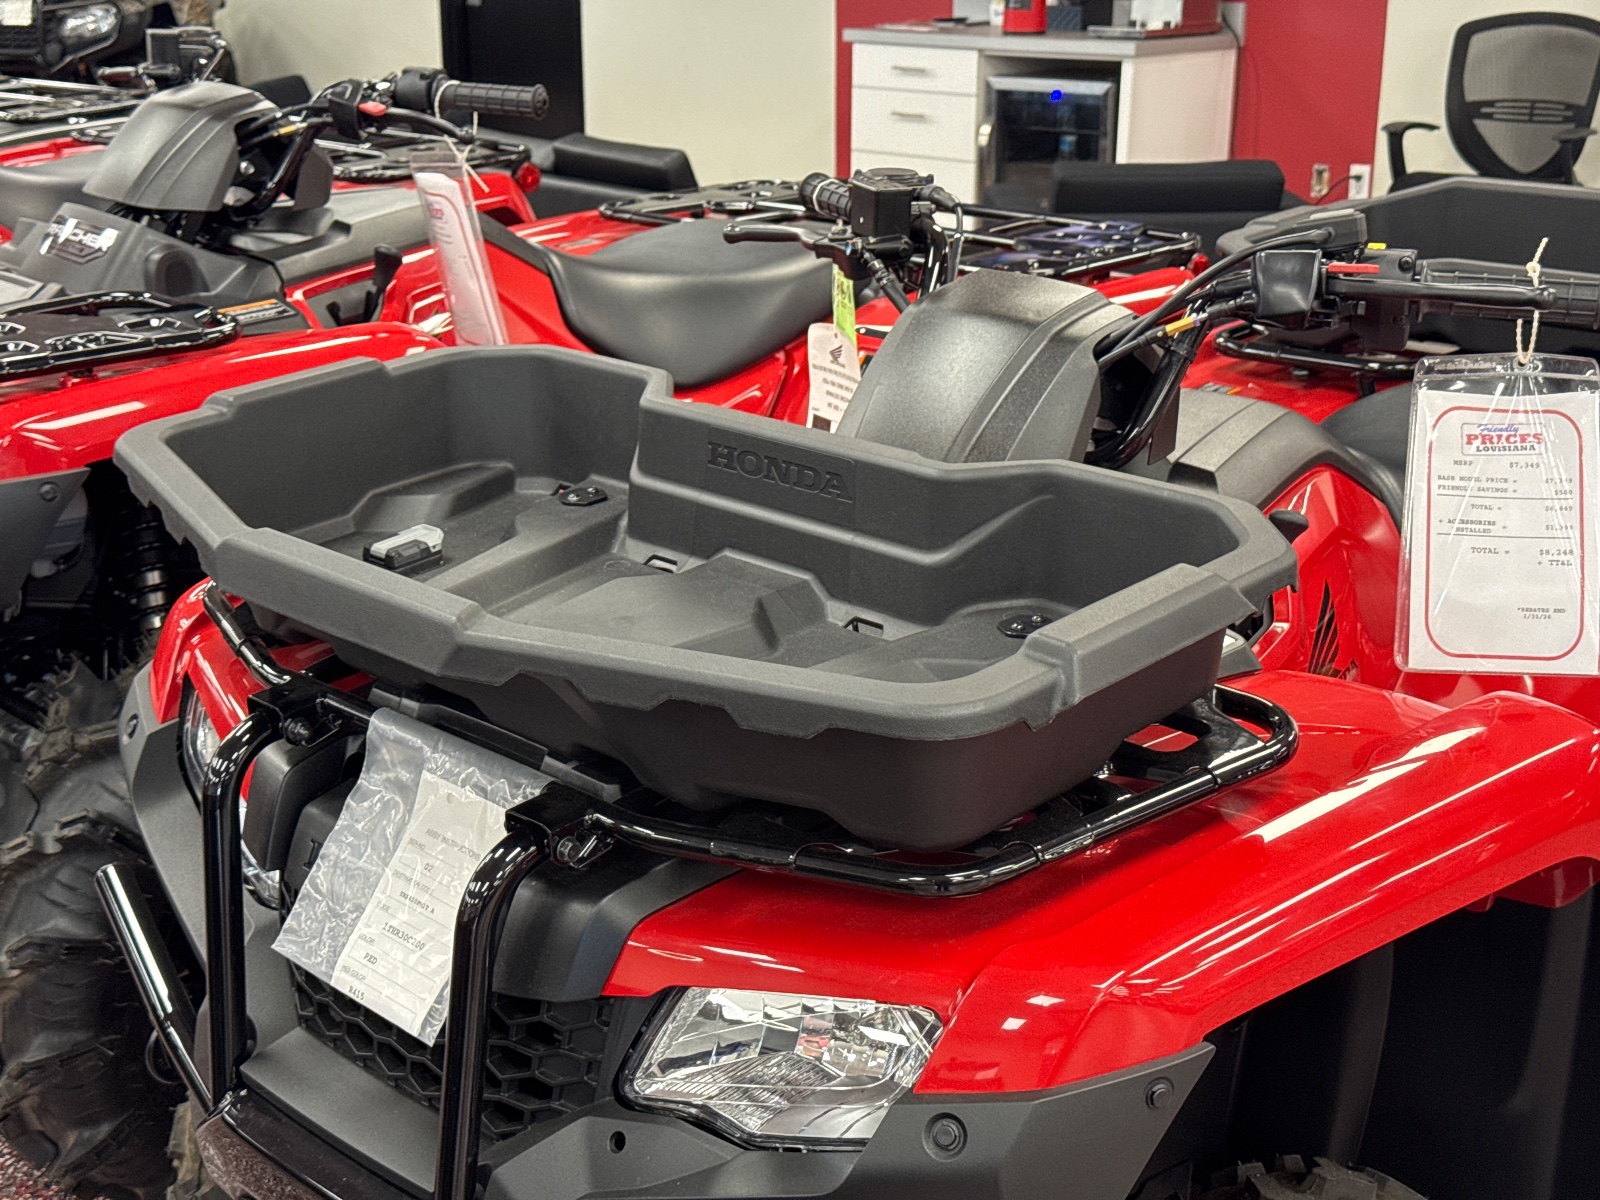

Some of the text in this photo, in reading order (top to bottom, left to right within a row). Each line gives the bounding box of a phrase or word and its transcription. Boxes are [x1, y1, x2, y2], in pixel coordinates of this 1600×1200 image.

[1477, 424, 1519, 434] Friendly
[1465, 433, 1544, 445] PRICES
[1476, 444, 1537, 452] LOUISIANA
[707, 441, 853, 503] HONDA
[1539, 549, 1574, 557] $8,248
[424, 863, 434, 873] 02
